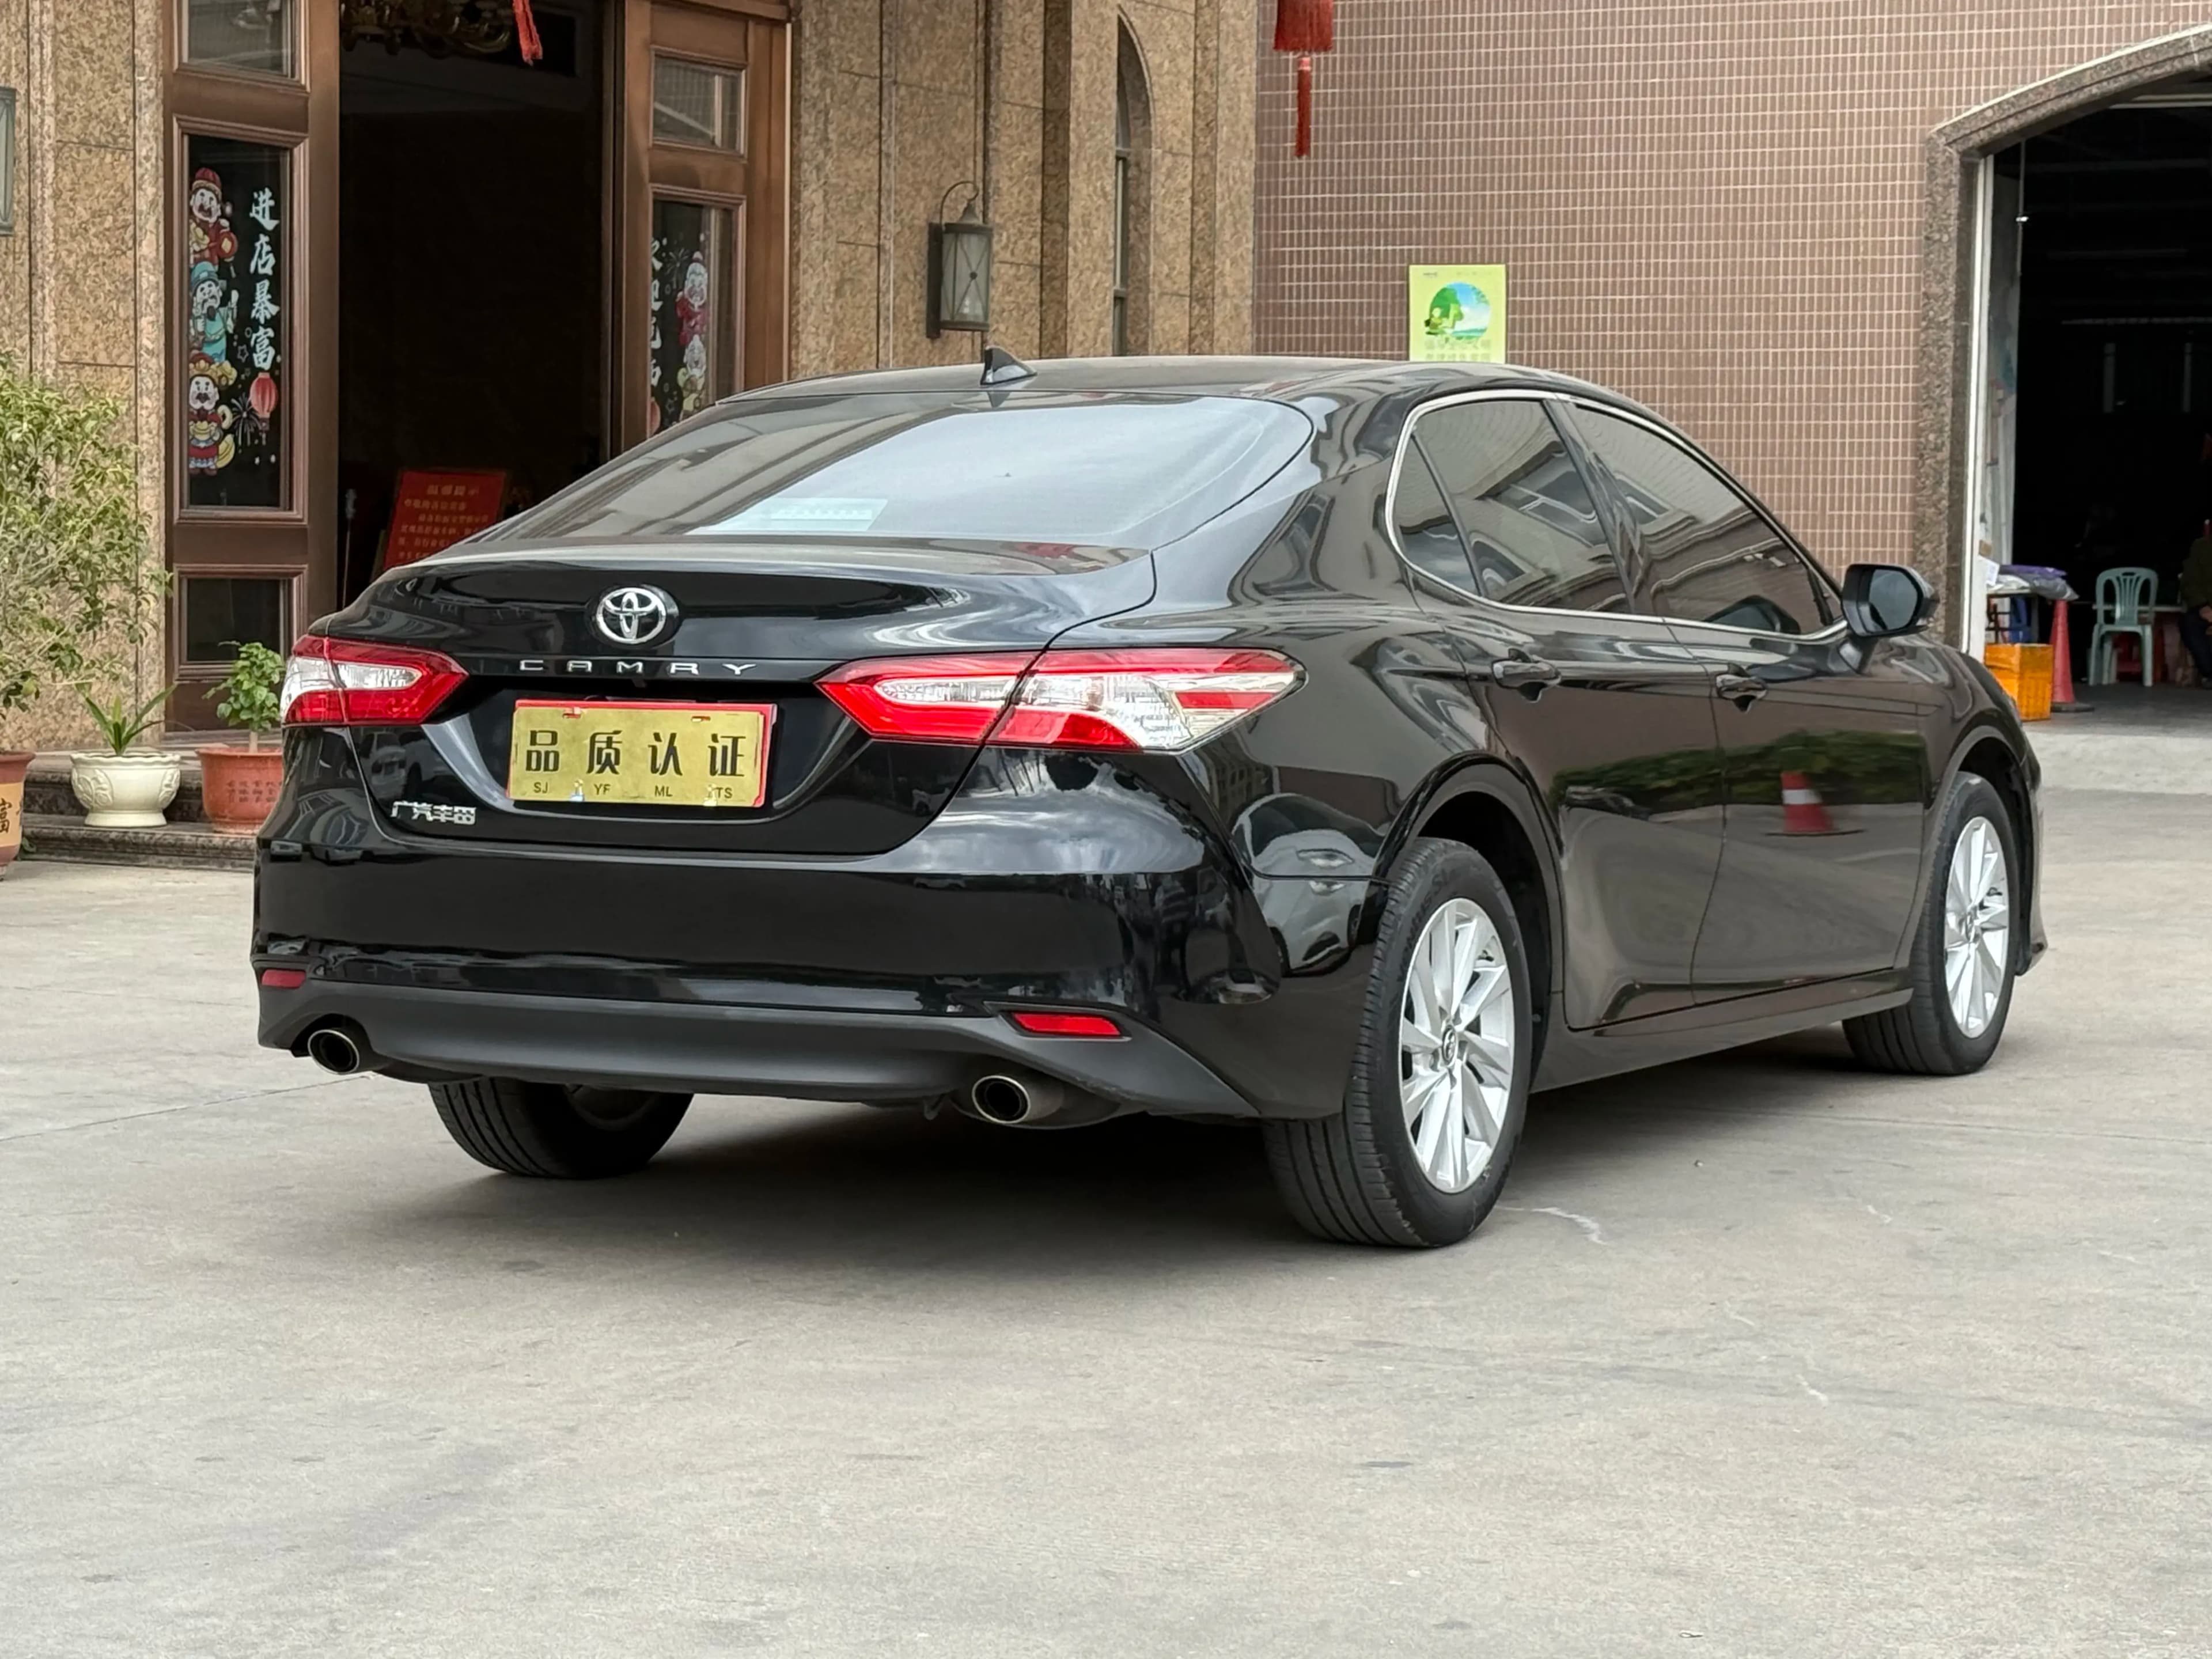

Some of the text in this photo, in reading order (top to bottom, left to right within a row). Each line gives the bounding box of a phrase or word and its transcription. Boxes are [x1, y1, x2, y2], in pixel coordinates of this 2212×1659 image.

[249, 187, 281, 370] 进店暴富
[520, 659, 756, 676] CAMRY
[525, 729, 747, 777] 品质认证
[533, 782, 733, 798] SJ YF ML TS
